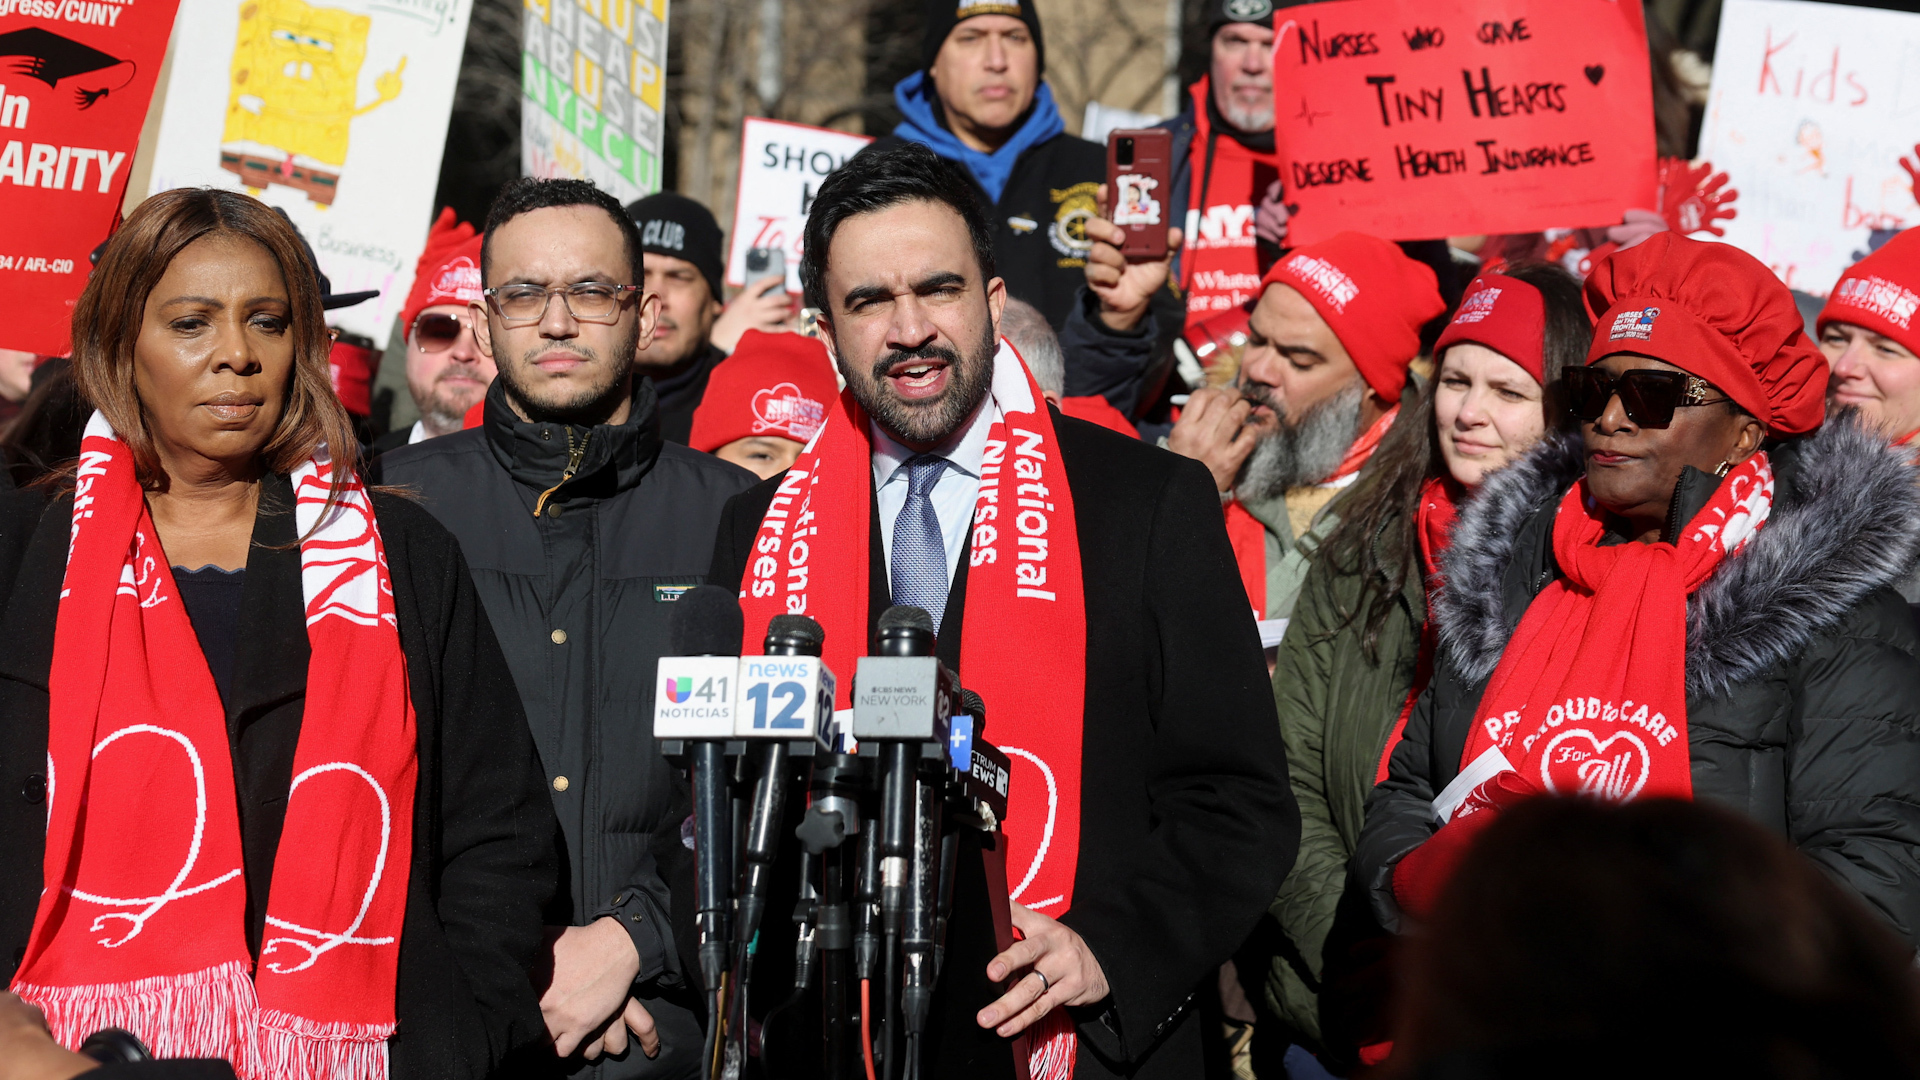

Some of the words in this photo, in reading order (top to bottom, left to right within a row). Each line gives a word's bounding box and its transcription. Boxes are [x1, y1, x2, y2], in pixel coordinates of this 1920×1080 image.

[1298, 20, 1380, 64] NURSES
[1758, 25, 1868, 107] Kids
[1365, 75, 1443, 127] TINY
[1460, 66, 1567, 118] HEARTS
[0, 139, 126, 194] ARITY
[1292, 157, 1375, 190] DESERVE
[1475, 140, 1595, 175] INSURANCE
[24, 256, 74, 275] AFL-CIO
[970, 440, 1008, 568] Nurses
[1012, 428, 1056, 602] National
[752, 469, 810, 599] Nurses
[694, 676, 729, 704] 41
[749, 664, 809, 678] news
[894, 686, 918, 694] NEWS
[660, 707, 730, 719] NOTICIAS
[746, 681, 808, 730] 12
[817, 688, 833, 747] 12
[860, 695, 891, 706] NEW
[893, 695, 928, 706] YORK
[1619, 700, 1679, 747] CARE
[971, 750, 997, 774] CTRUM
[972, 763, 996, 788] EWS
[1555, 746, 1591, 764] For
